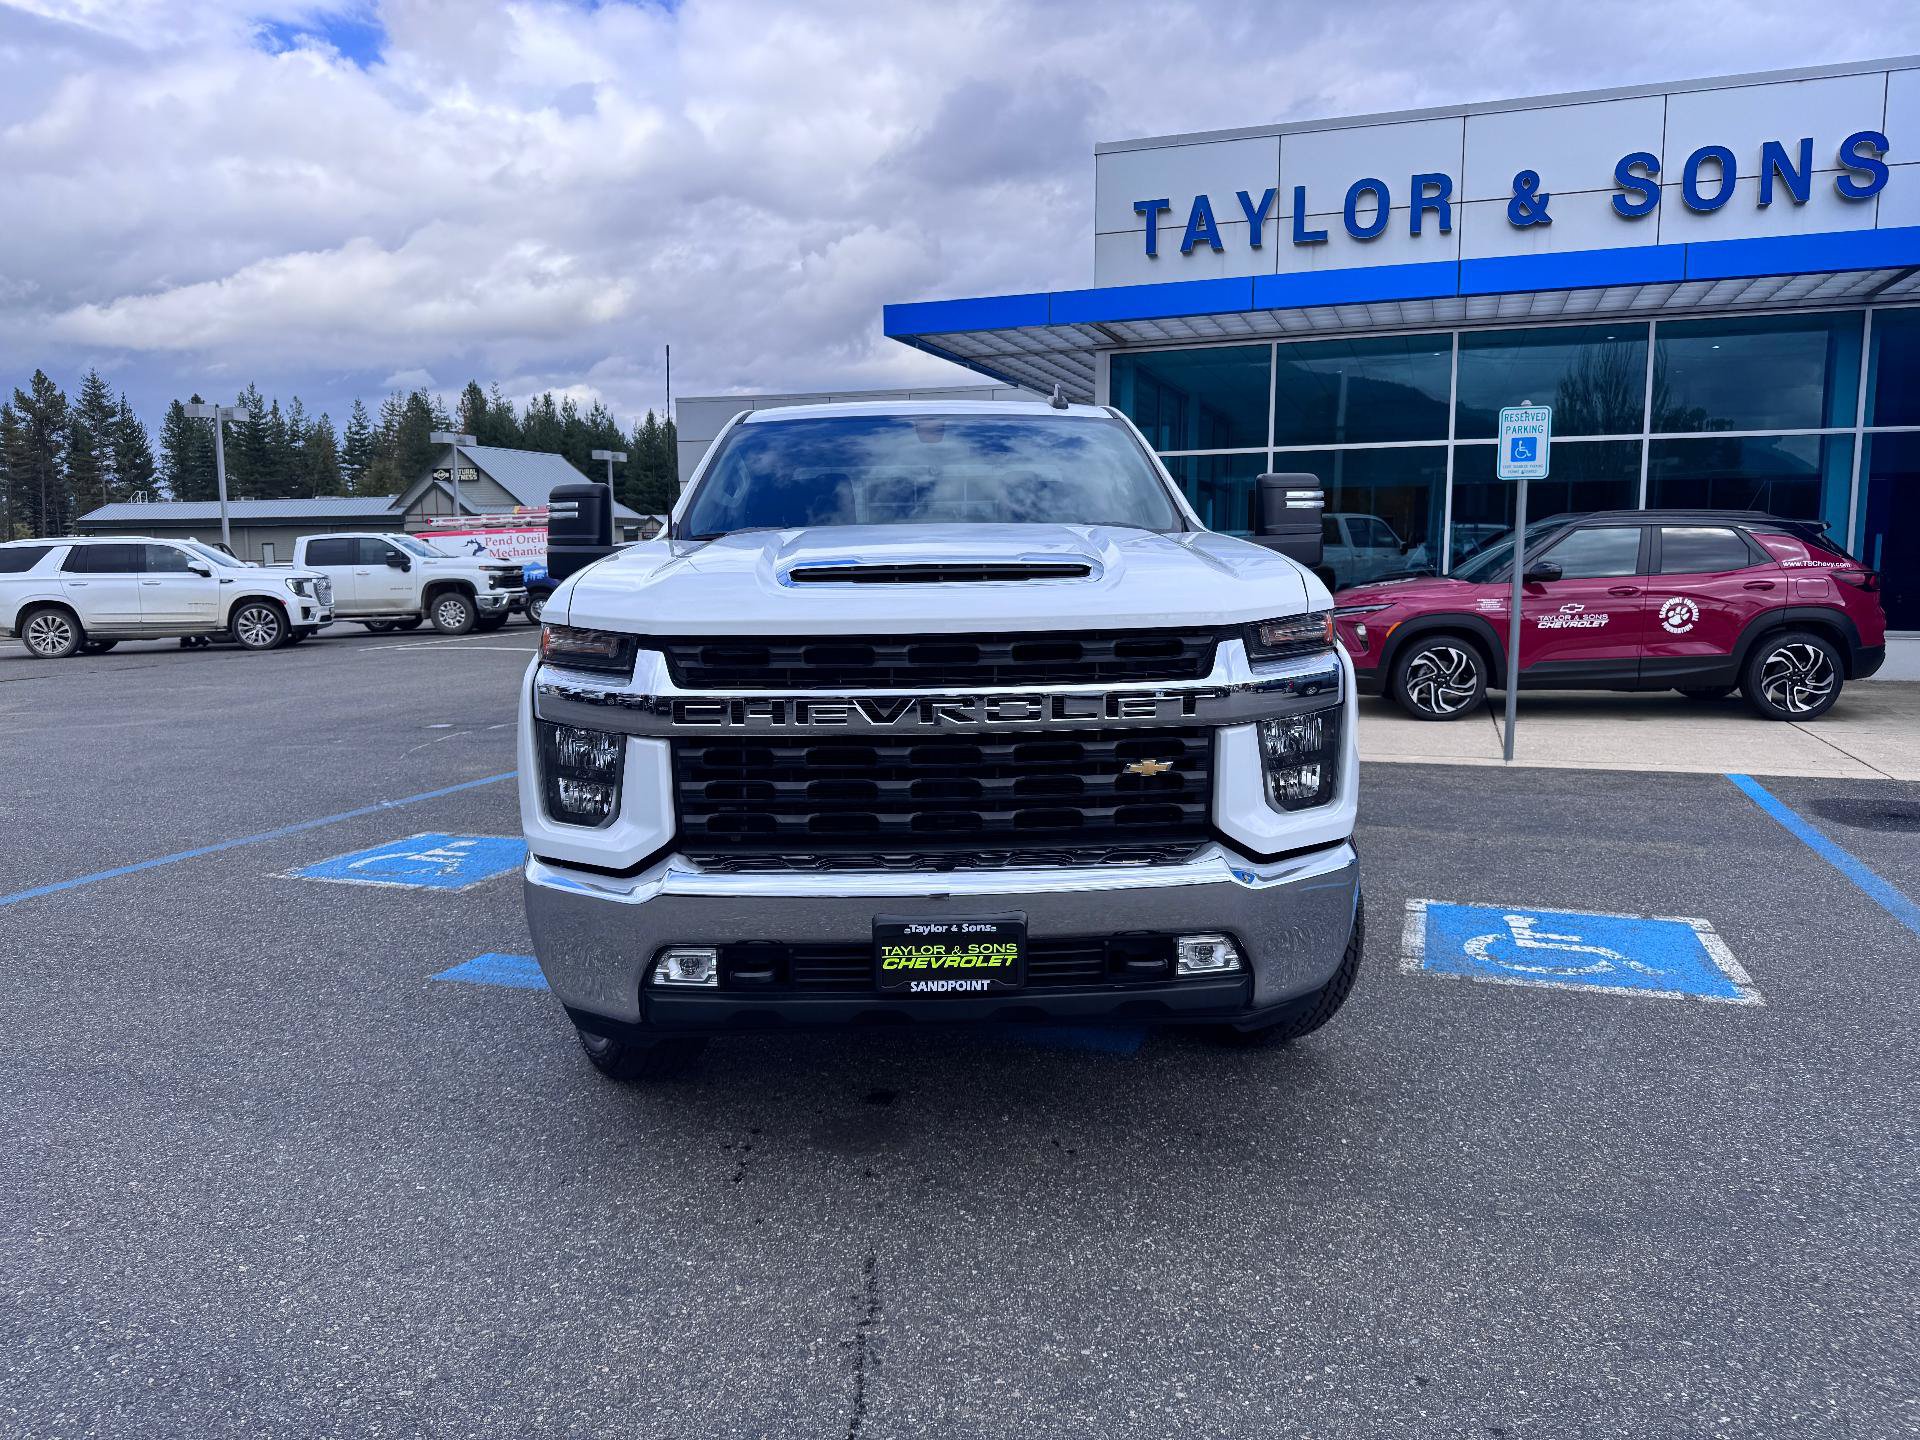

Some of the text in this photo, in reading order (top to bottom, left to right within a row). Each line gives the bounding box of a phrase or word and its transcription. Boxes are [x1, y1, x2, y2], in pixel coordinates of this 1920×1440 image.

[1133, 130, 1890, 257] TAYLOR & SONS
[1504, 412, 1547, 422] RESERVED
[1505, 425, 1544, 434] PARKING
[485, 535, 513, 546] Pend
[1781, 560, 1851, 568] www.TSChevy.com
[1537, 621, 1610, 629] CHEVROLET
[671, 690, 1215, 726] CHEVROLET
[908, 923, 991, 935] Taylor & Sons
[882, 943, 1018, 956] TAYLOR & SONS
[882, 955, 1018, 970] CHEVROLET
[910, 980, 991, 992] SANDPOINT
